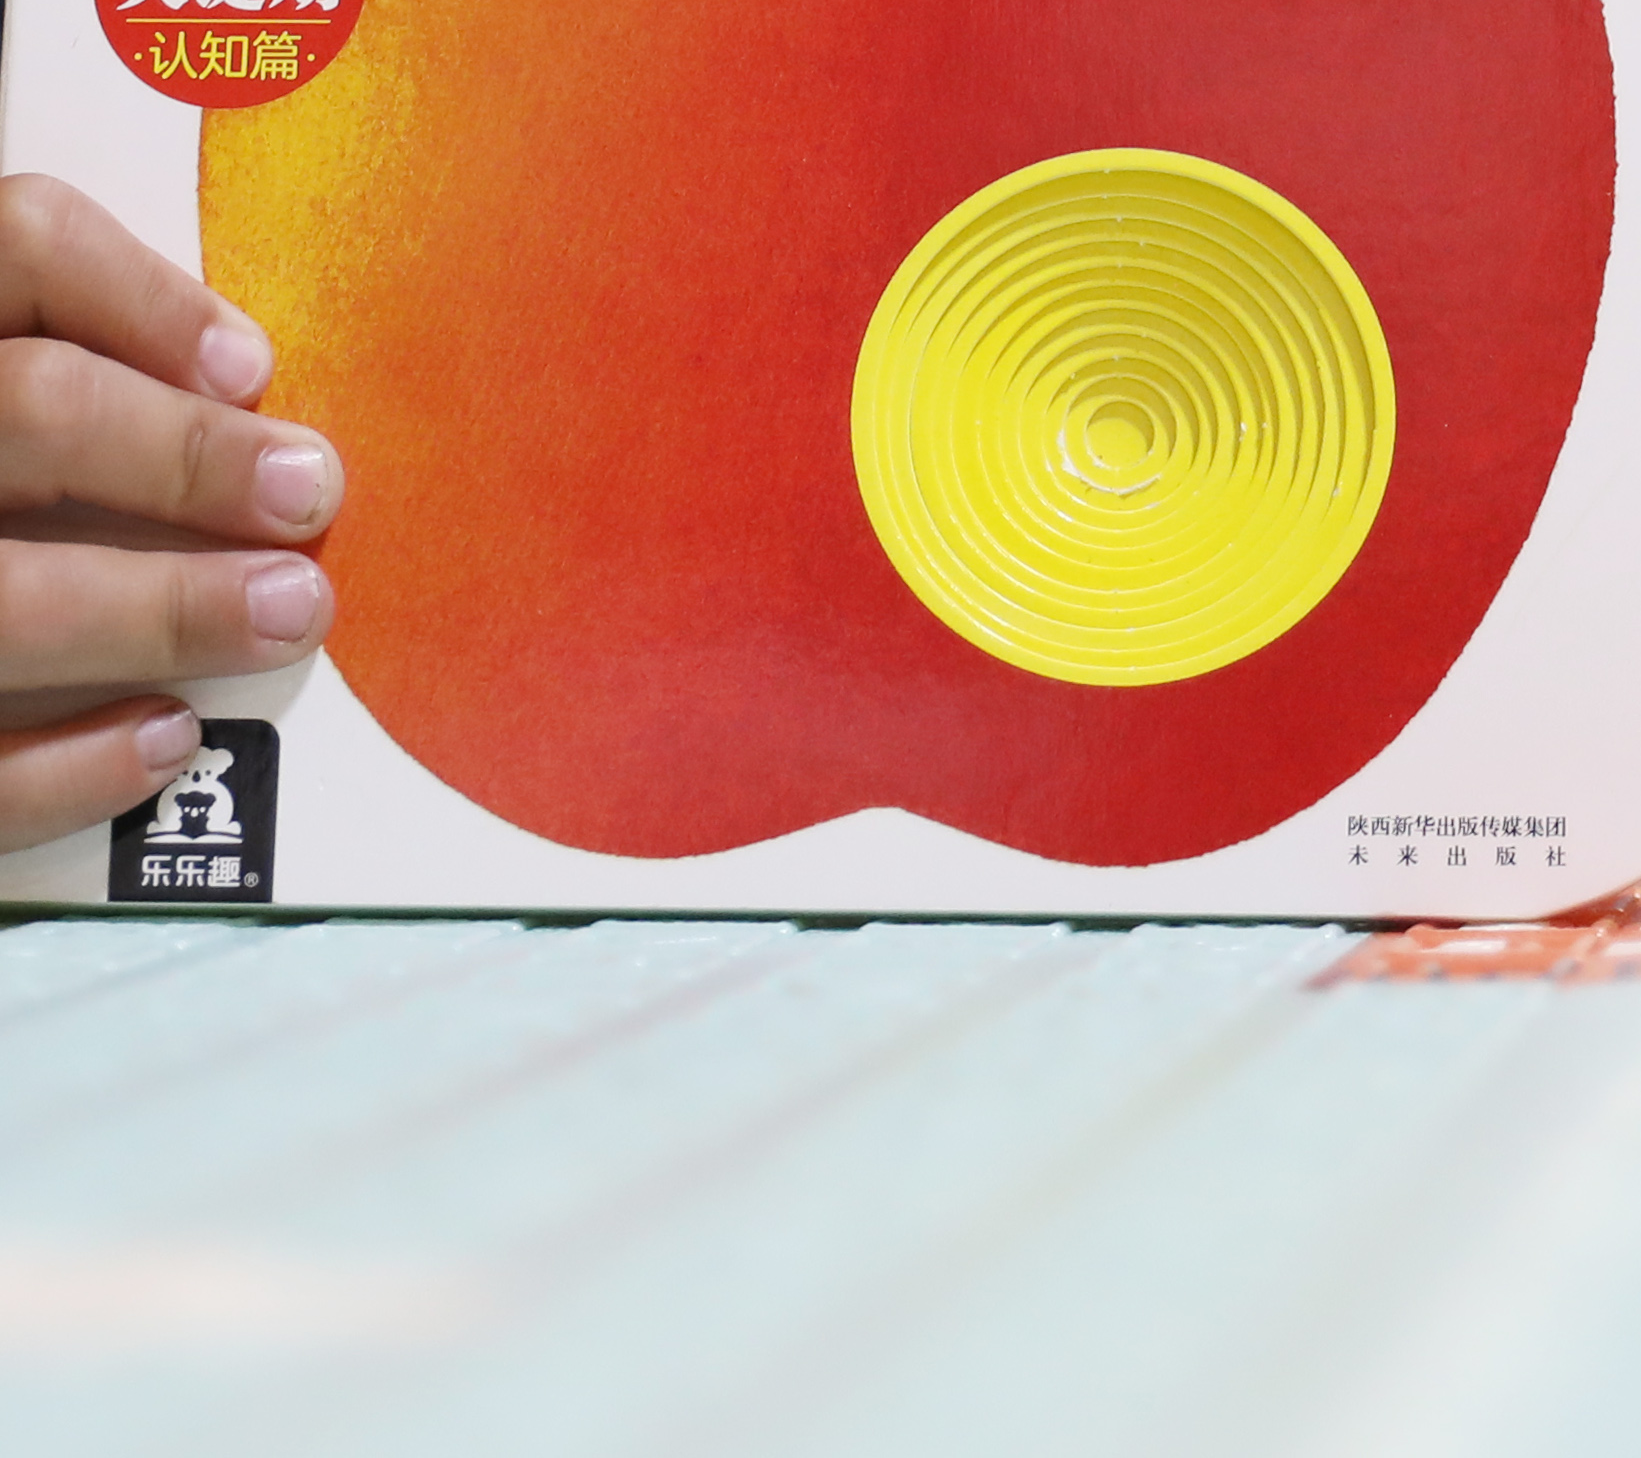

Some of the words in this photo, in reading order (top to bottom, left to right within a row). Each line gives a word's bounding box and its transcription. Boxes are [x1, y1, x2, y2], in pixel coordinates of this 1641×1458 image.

[1347, 814, 1567, 838] 陕西新华出版传媒集团
[1348, 844, 1567, 867] 未来出版社
